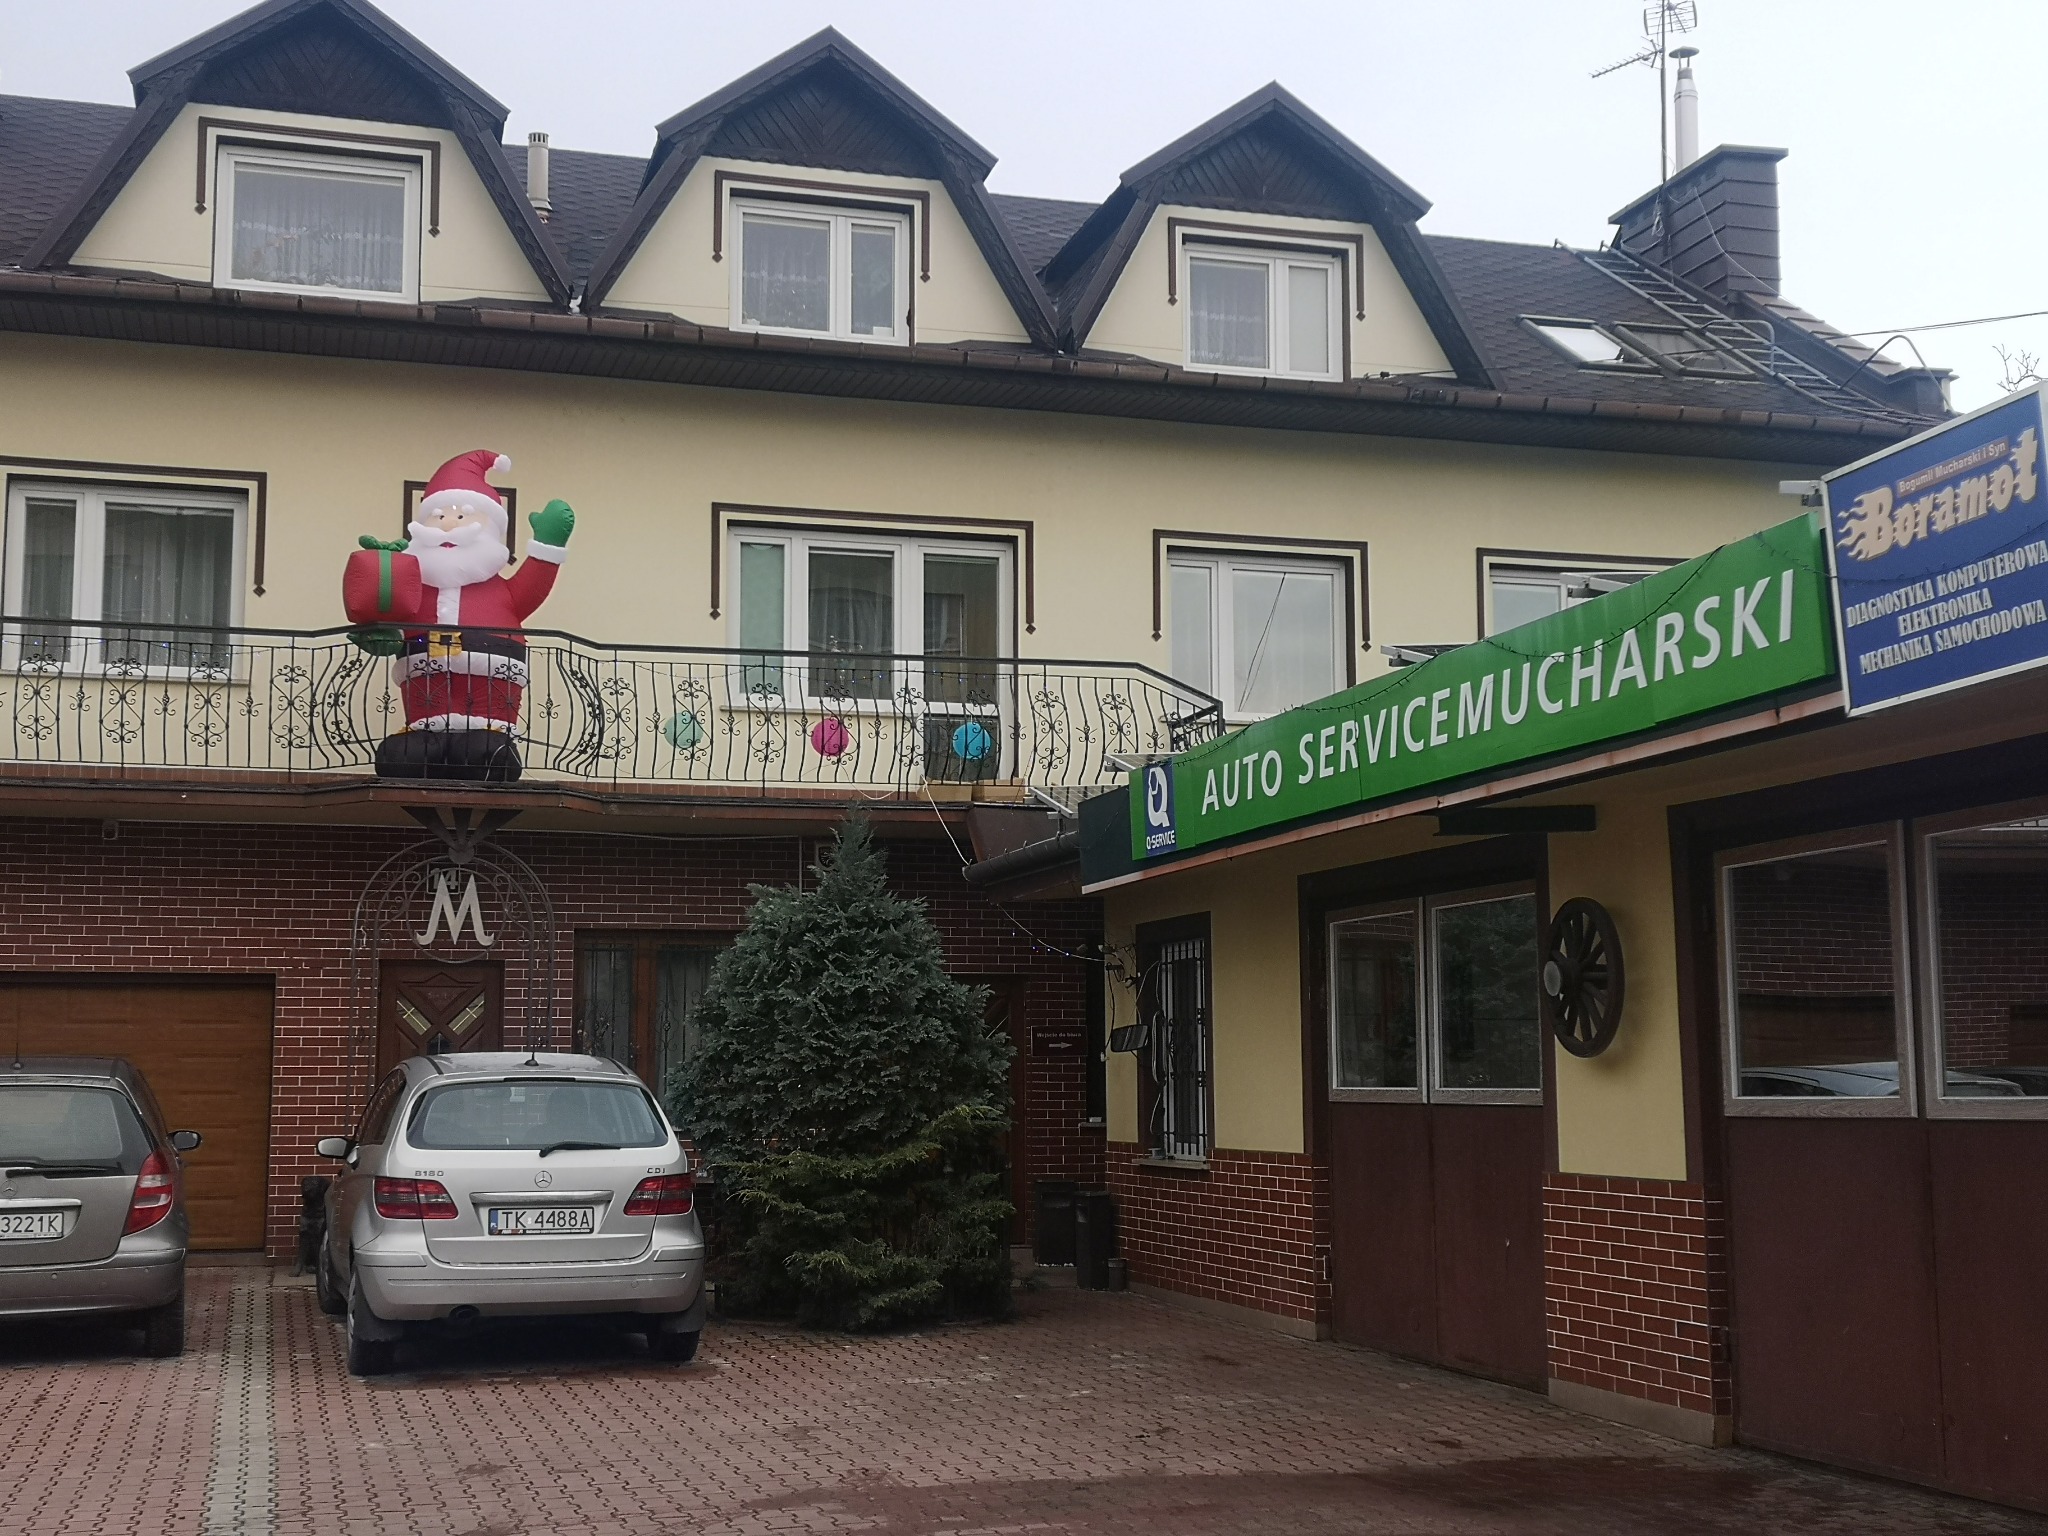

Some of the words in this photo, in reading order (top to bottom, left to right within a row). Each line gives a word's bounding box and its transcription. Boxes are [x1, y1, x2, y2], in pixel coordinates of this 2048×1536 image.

[1935, 449, 1981, 478] Mucharski
[1988, 442, 2006, 457] Syn
[1836, 427, 2038, 561] Boramot
[1846, 579, 1935, 628] DIAGNOSTYKA
[1936, 540, 2048, 597] KOMPUTEROWA
[1859, 634, 1934, 675] MECHANIKA
[1934, 599, 2048, 652] SAMOCHODOWA
[1898, 588, 1993, 637] ELEKTRONIKA
[1201, 750, 1283, 815] AUTO
[1146, 830, 1176, 850] Q-SERVICE
[430, 867, 459, 890] 14
[416, 873, 495, 945] M
[1, 1215, 59, 1233] 3221K
[501, 1211, 527, 1229] TK
[534, 1209, 590, 1228] 4488A
